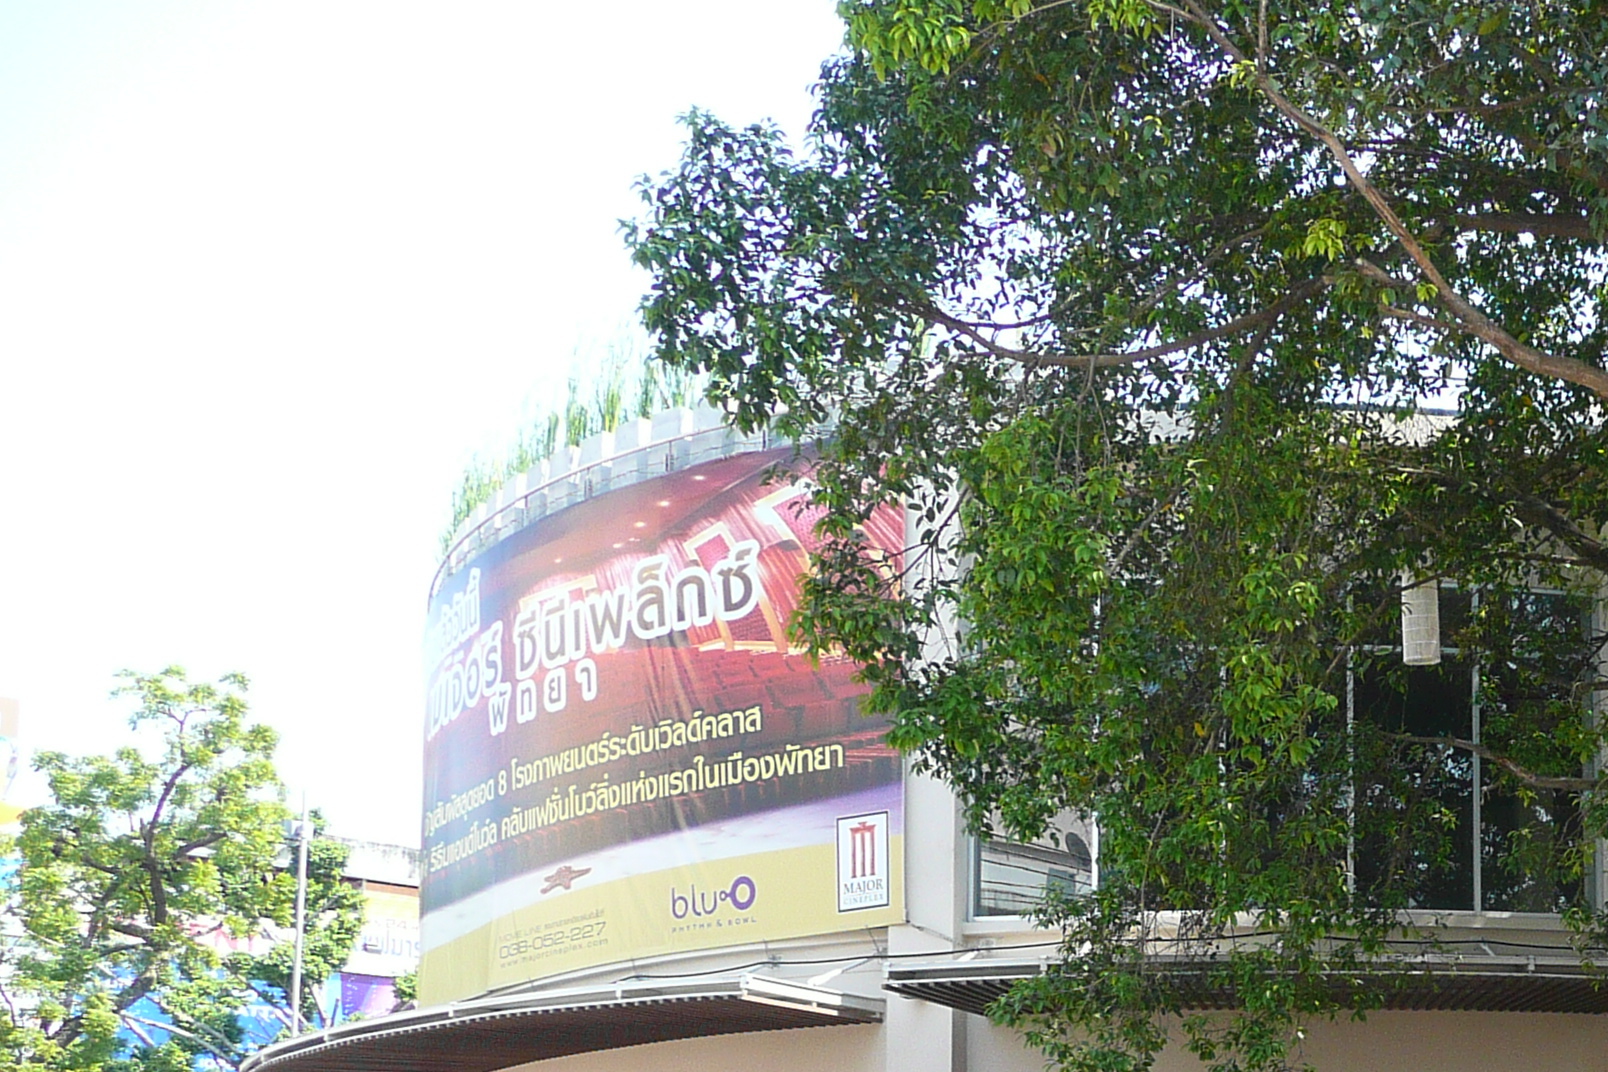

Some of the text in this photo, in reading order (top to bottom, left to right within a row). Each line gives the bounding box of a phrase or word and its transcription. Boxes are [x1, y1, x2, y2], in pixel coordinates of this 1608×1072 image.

[514, 540, 760, 679] ซีนีเพล็กซ์
[489, 659, 597, 737] พัทยา
[497, 769, 508, 796] 8
[842, 893, 884, 906] CINEPLEX
[843, 878, 884, 895] MAJOR
[727, 915, 758, 926] BOWL
[499, 921, 607, 959] 038-052-227
